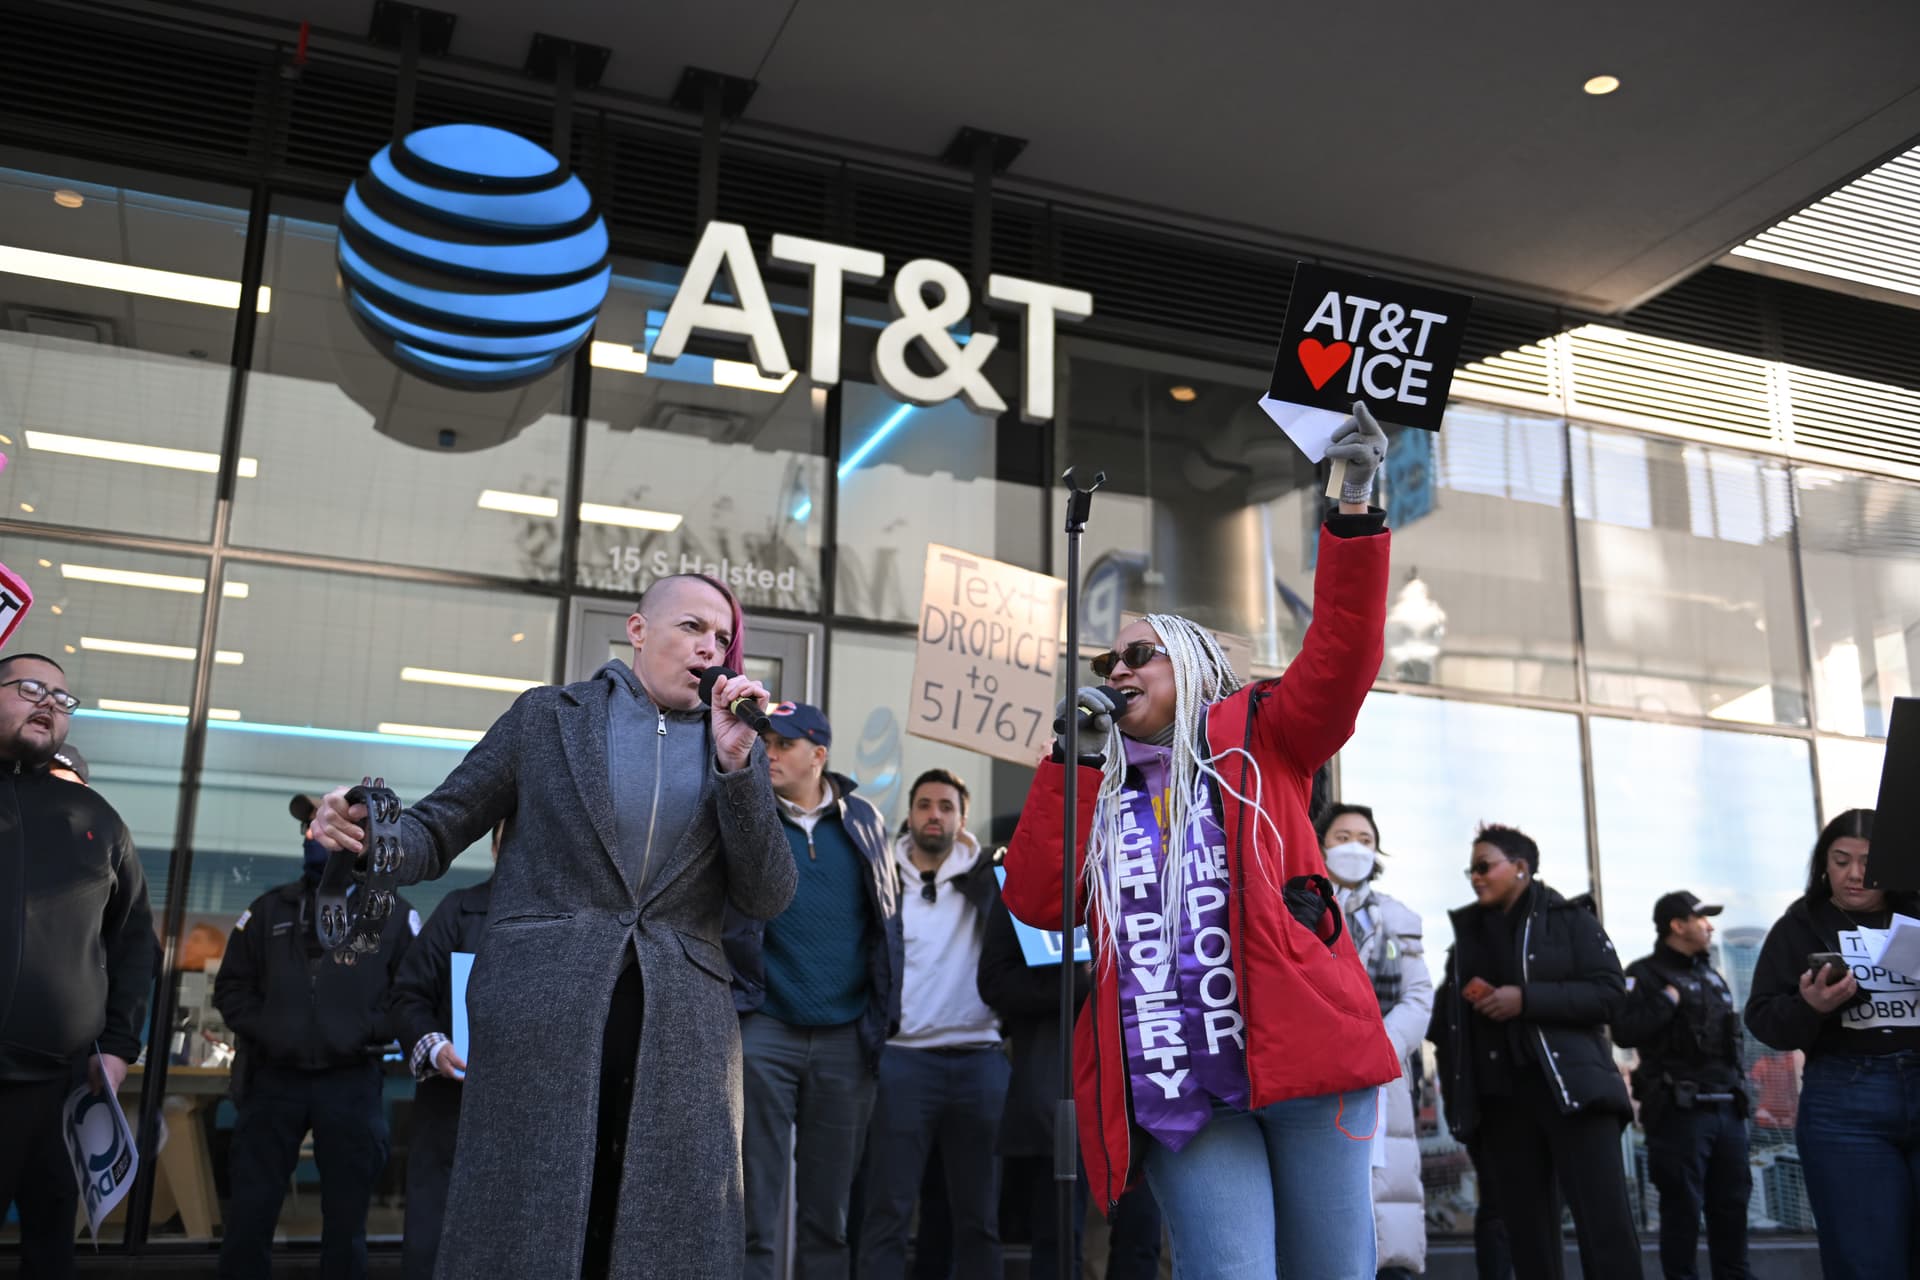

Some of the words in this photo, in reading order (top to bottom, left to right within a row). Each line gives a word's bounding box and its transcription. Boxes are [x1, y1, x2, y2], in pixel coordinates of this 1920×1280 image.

[649, 221, 1093, 421] AT&T
[1303, 291, 1448, 357] AT&T
[1347, 346, 1433, 406] ICE
[609, 546, 641, 573] 15
[652, 551, 669, 576] S
[680, 553, 796, 592] Halsted
[940, 553, 1049, 624] Text
[922, 604, 1055, 677] DROPICE
[966, 665, 999, 694] to
[921, 681, 1042, 748] 51767
[1117, 790, 1158, 900] FIGHT
[1181, 845, 1230, 886] THE
[1187, 886, 1244, 1055] POOR
[1124, 912, 1190, 1099] POVERTY
[1848, 1000, 1919, 1022] LOBBY
